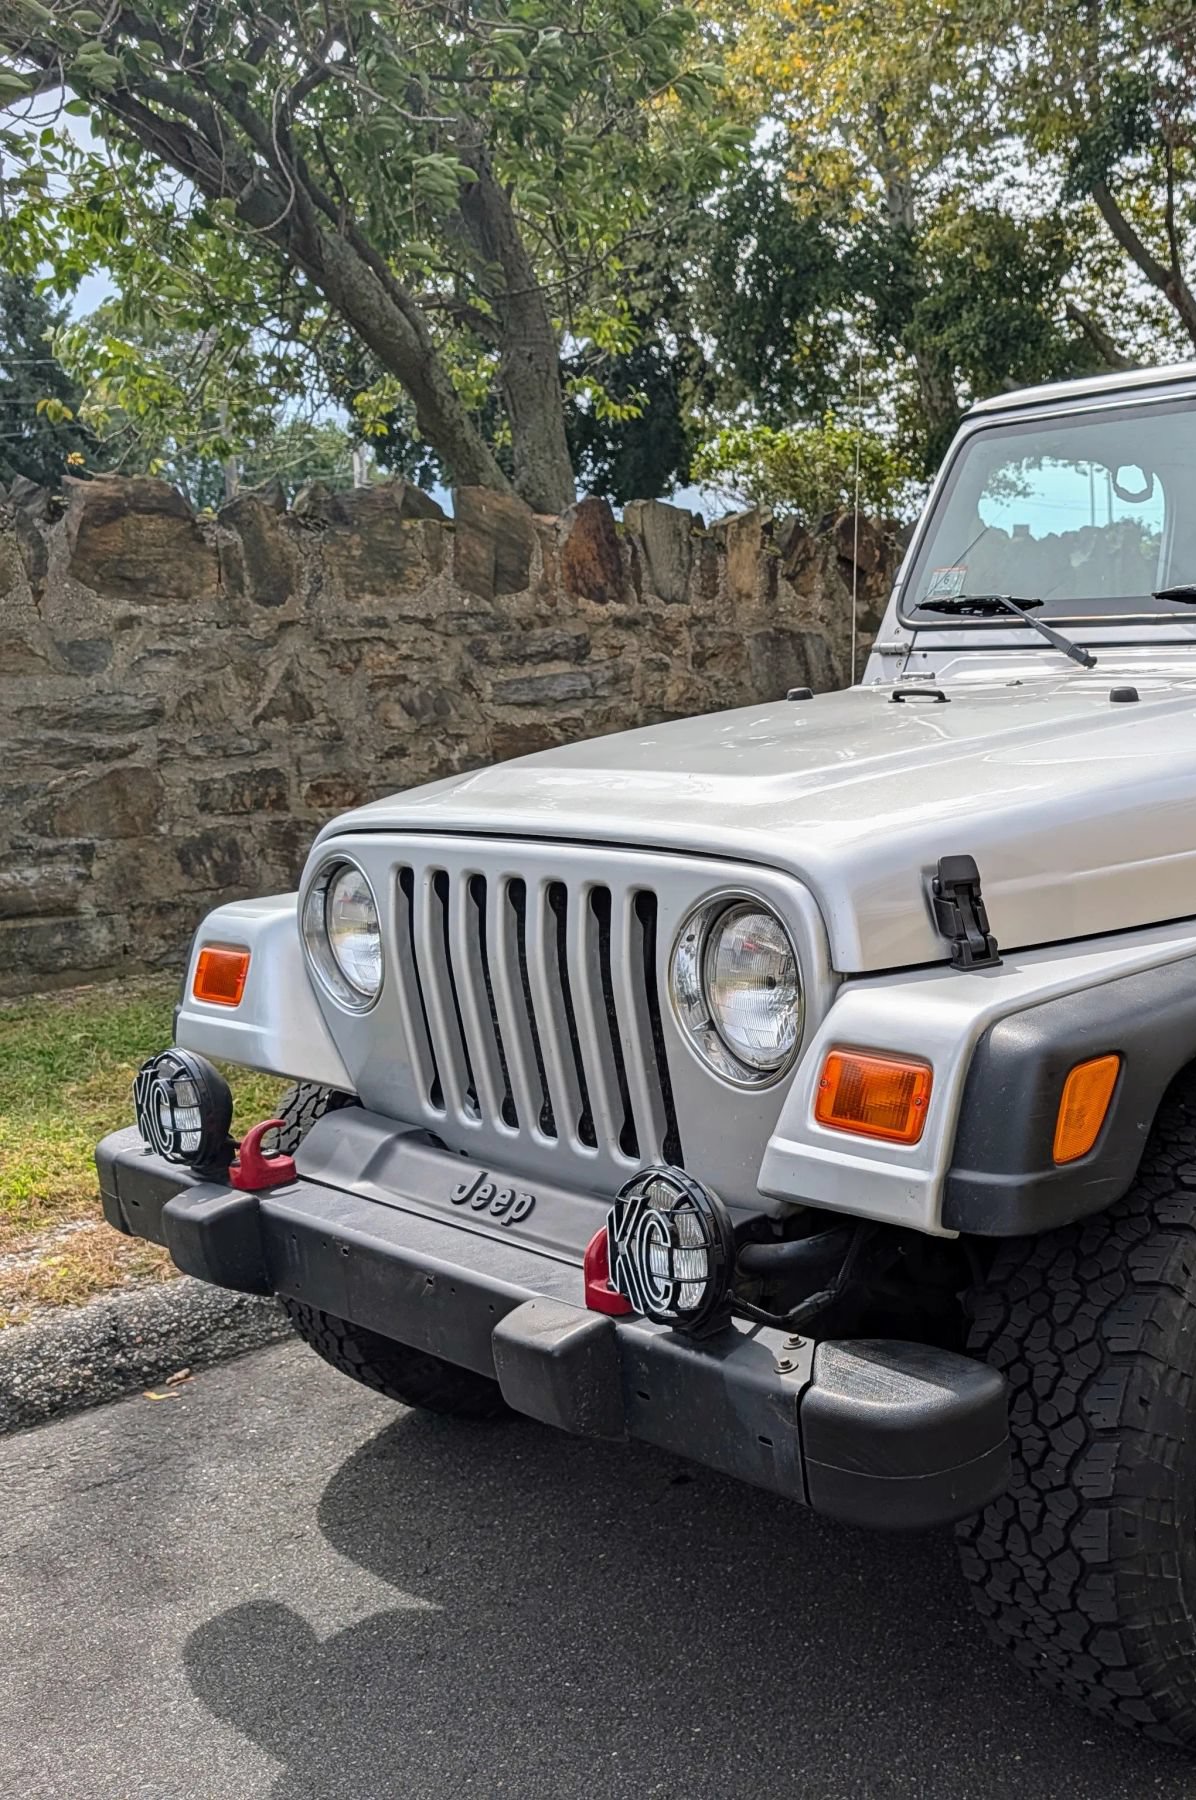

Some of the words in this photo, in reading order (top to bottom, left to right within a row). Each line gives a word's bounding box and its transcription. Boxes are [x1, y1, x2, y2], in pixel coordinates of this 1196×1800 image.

[132, 1069, 175, 1156] KC
[450, 1170, 537, 1227] Jeep
[605, 1196, 673, 1316] KC
